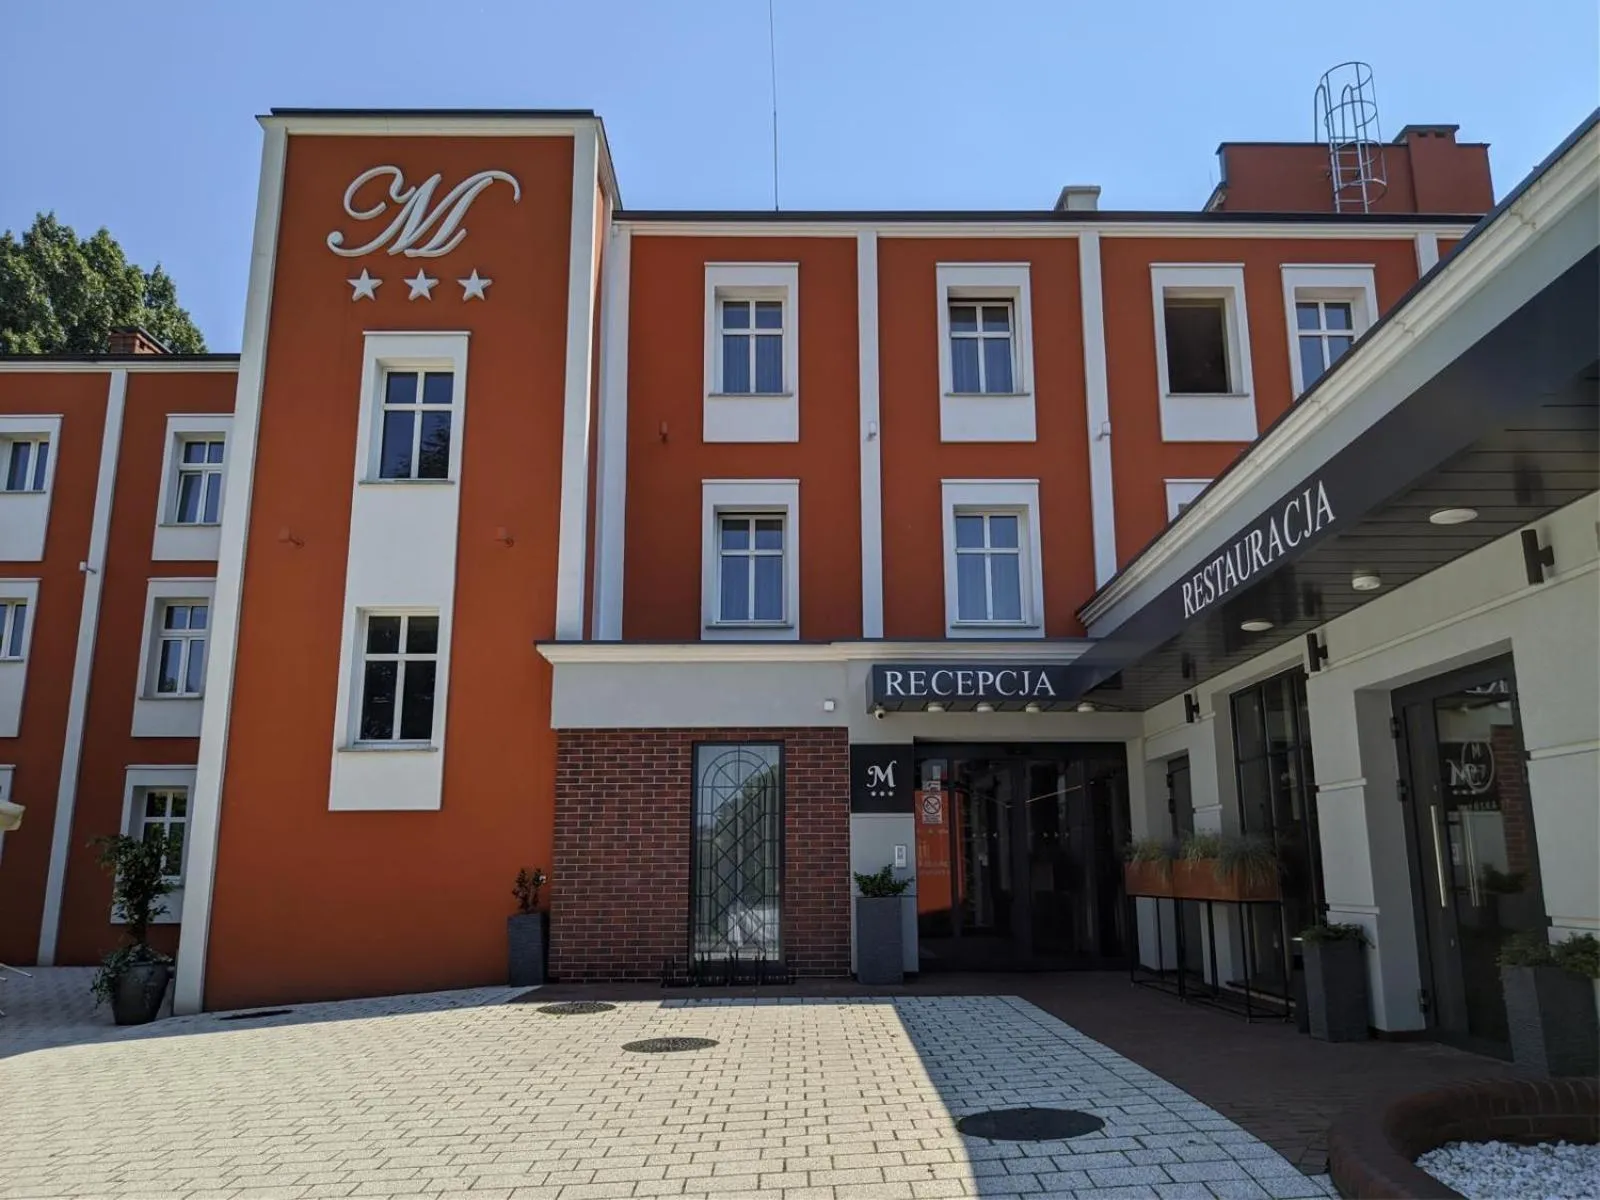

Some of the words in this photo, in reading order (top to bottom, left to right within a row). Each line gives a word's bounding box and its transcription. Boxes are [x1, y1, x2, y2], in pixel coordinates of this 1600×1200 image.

[327, 164, 521, 258] M
[1181, 480, 1336, 619] RESTAURACJA
[885, 669, 1056, 697] RECEPCJA
[866, 760, 898, 788] M
